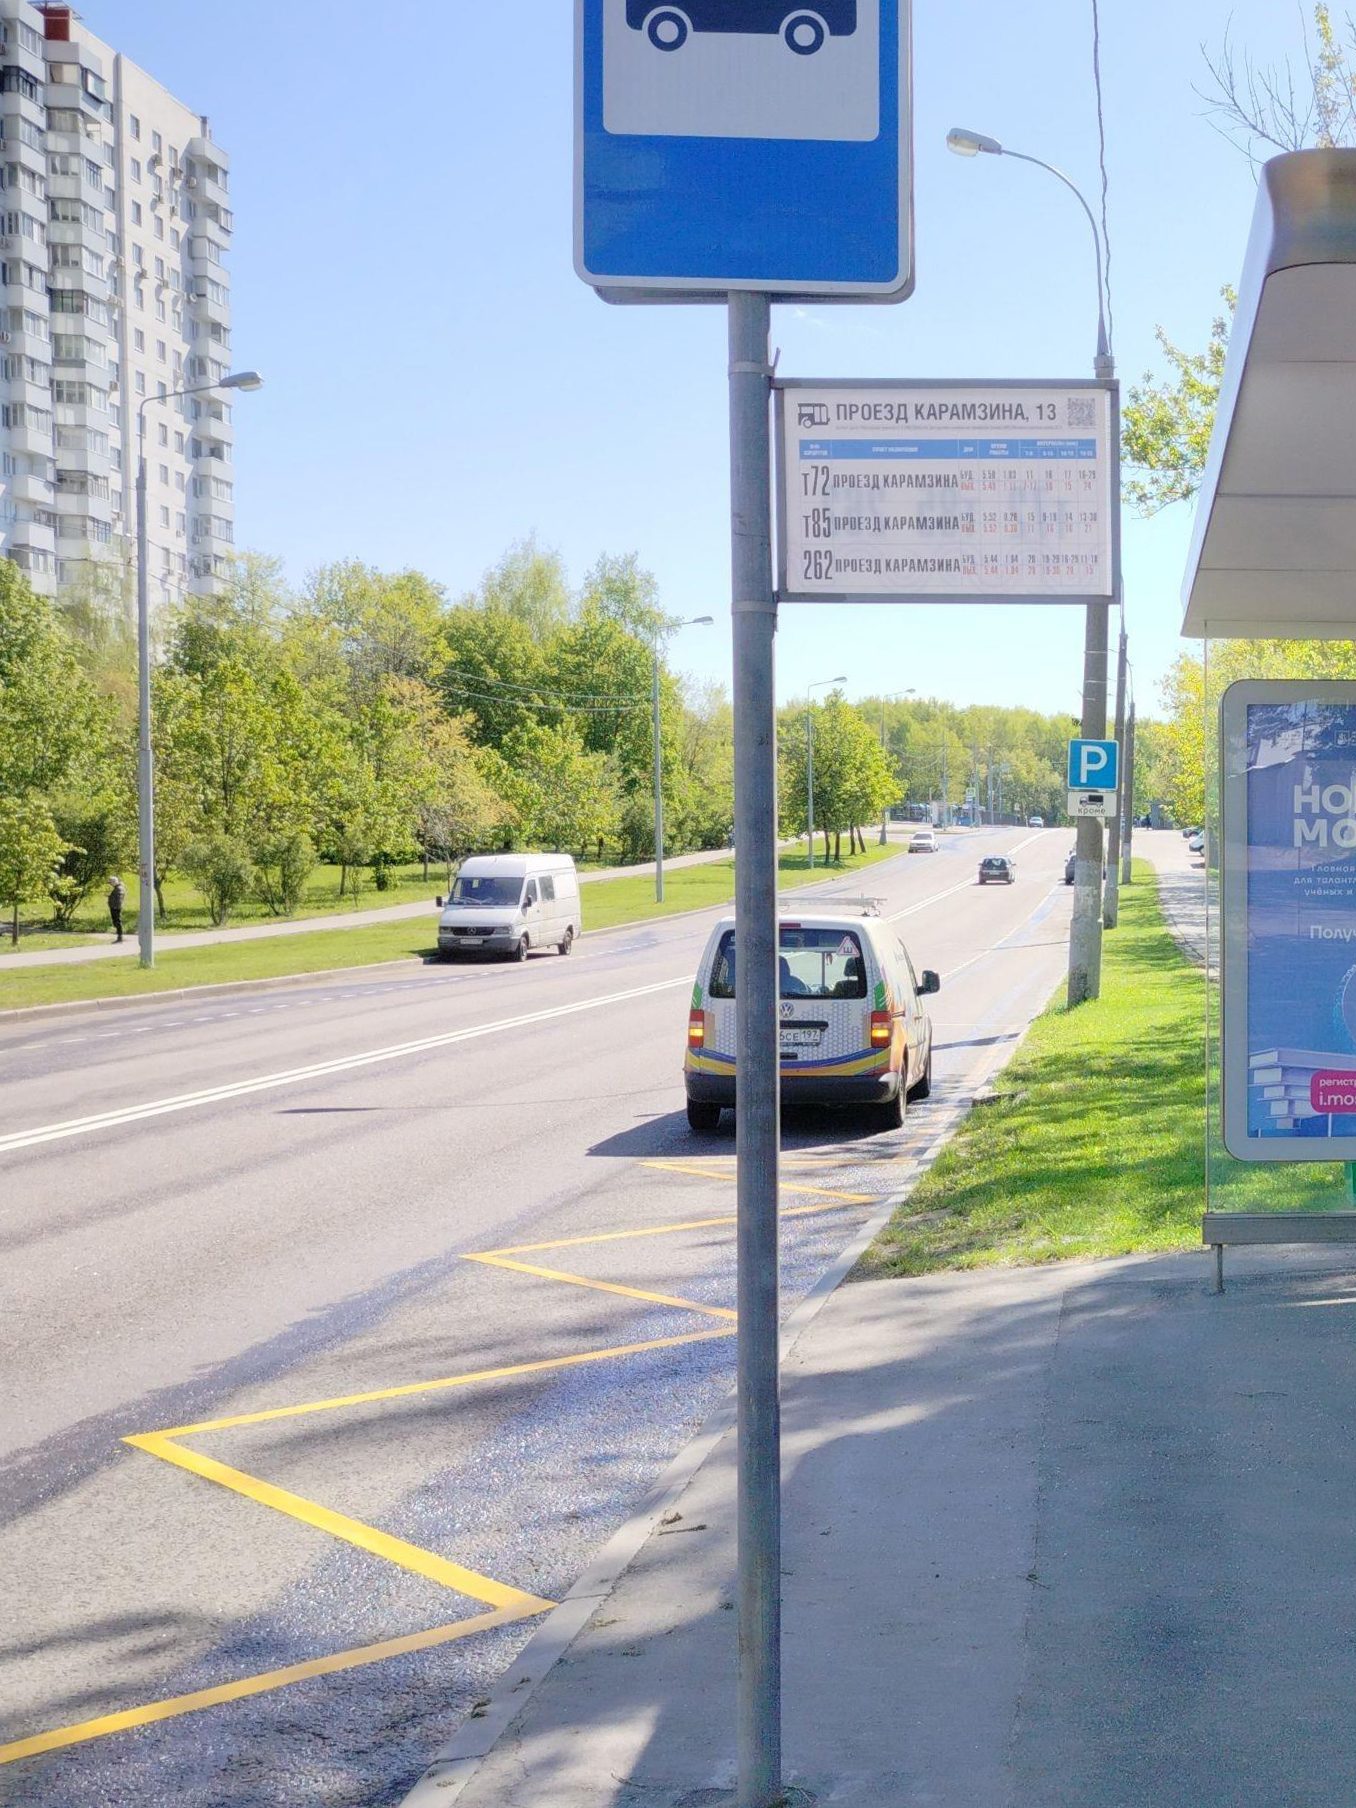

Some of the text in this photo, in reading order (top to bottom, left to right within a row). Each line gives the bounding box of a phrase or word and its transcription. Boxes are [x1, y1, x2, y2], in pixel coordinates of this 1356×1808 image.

[836, 403, 1057, 424] ПРОЕЗД КАРАМЗИНА, 13
[833, 474, 880, 490] ПРОЕЗД
[883, 473, 959, 488] КАРАМЗИНА
[834, 516, 881, 532] ПРОЕЗД
[884, 515, 960, 531] КАРАМЗИНА
[803, 550, 961, 580] 262 ПРОЕЗД КАРАМЗИНА
[1080, 744, 1107, 784] P
[1294, 877, 1313, 885] для
[802, 1029, 818, 1039] 197
